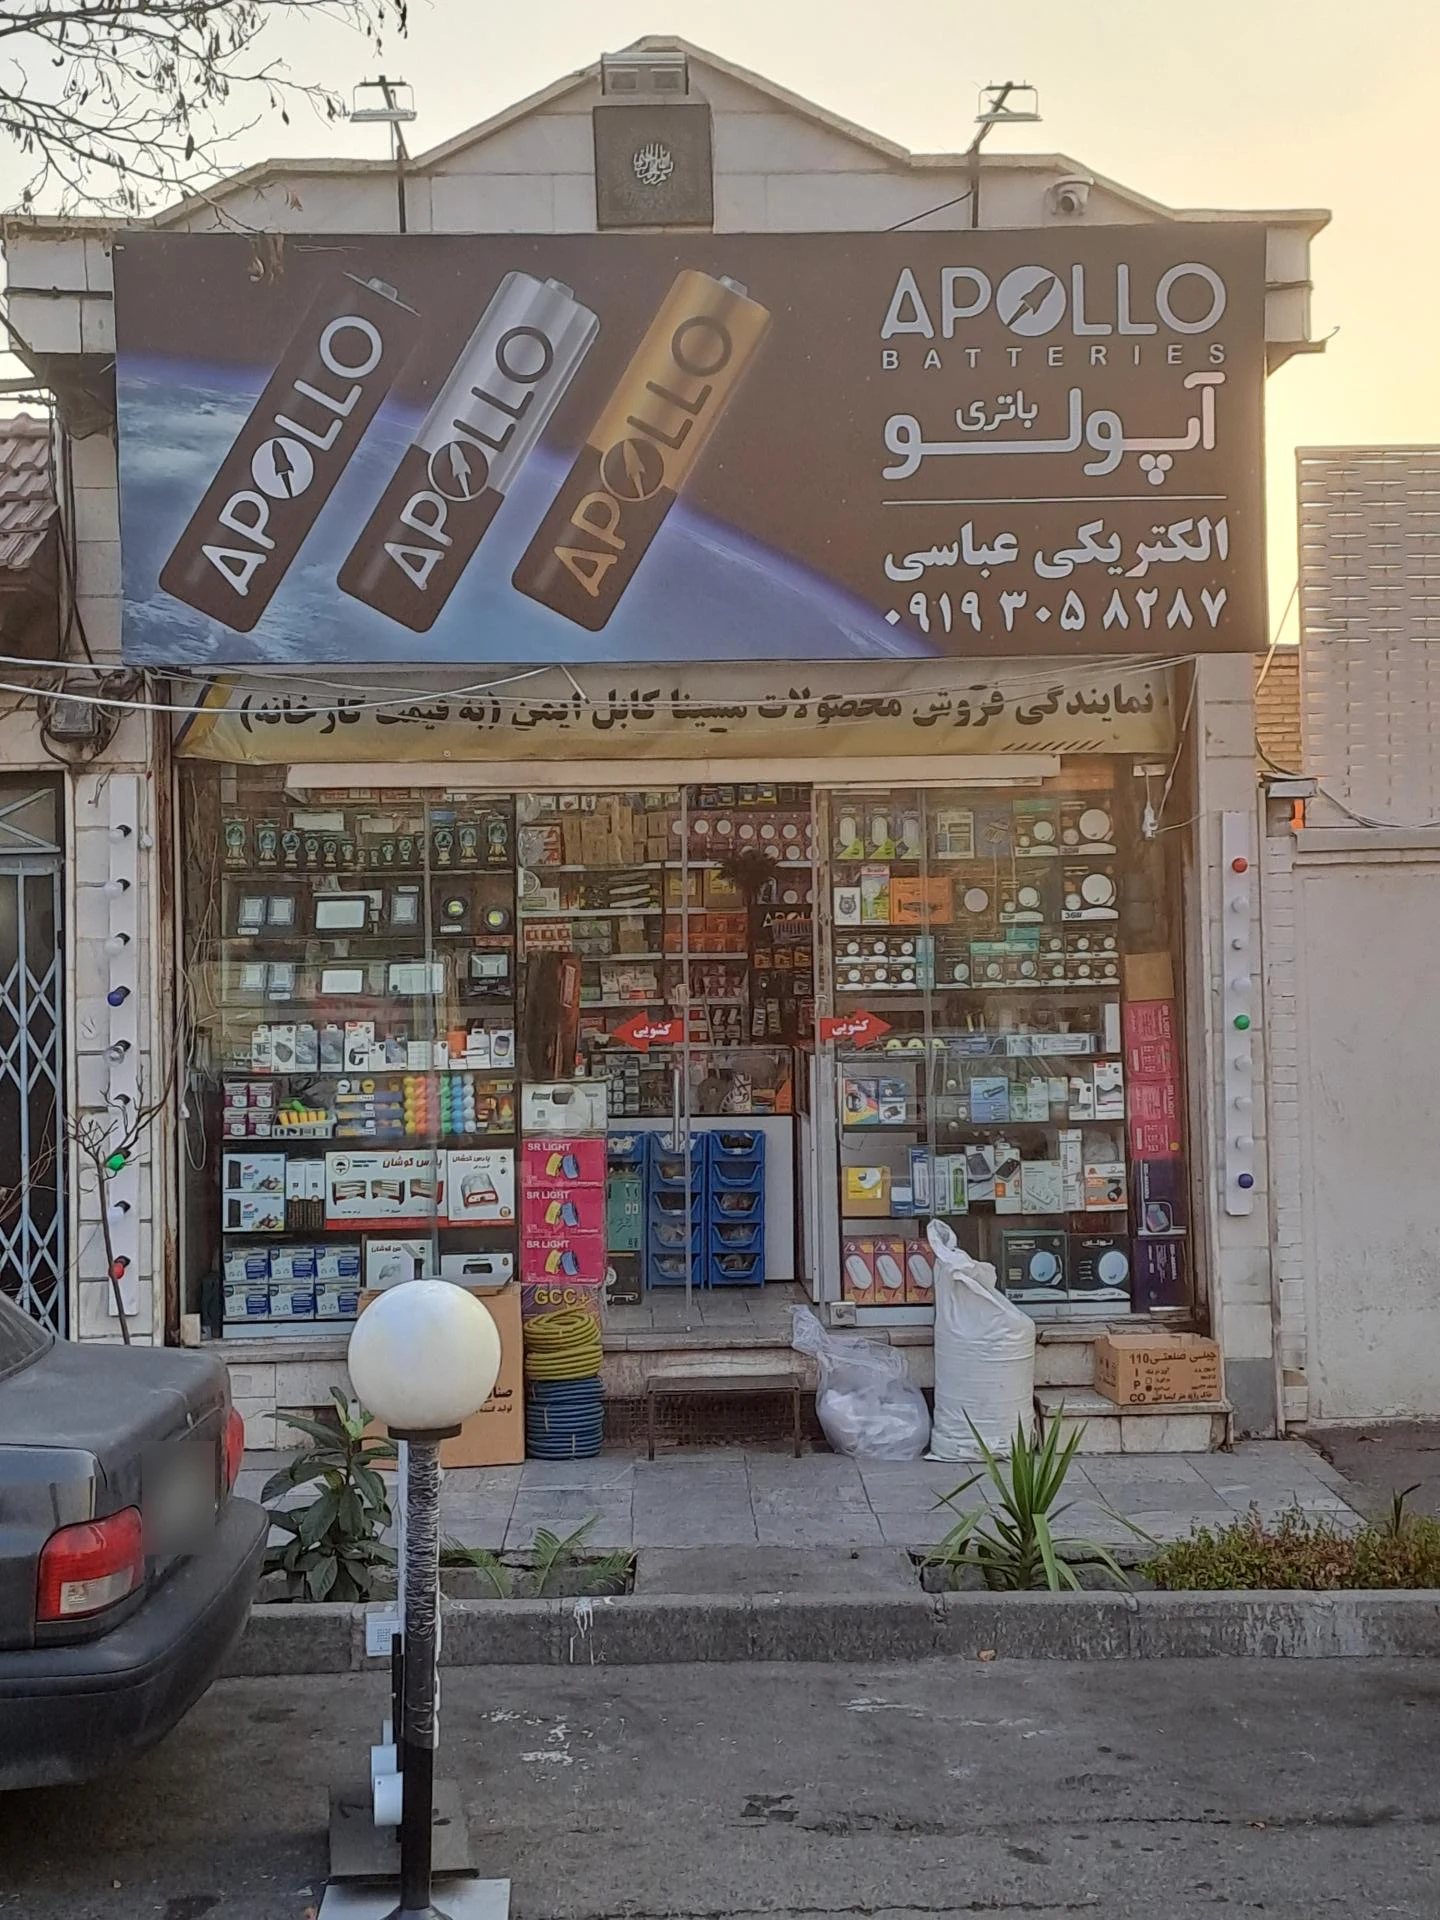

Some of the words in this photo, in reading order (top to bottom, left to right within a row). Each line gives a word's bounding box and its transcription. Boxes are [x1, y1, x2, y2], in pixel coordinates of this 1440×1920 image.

[880, 262, 1227, 340] APOLLO
[881, 344, 1226, 370] BATTERIES
[881, 371, 1227, 486] آپولو
[955, 389, 1039, 431] باتری
[202, 315, 383, 596] APOLLO
[384, 324, 554, 591] APOLLO
[554, 315, 733, 597] APOLLO
[883, 520, 1020, 582] عباسی
[1033, 516, 1230, 579] الکتریکی
[375, 698, 450, 730] قیمت
[591, 688, 661, 730] کابل
[756, 686, 901, 728] محصولات
[912, 682, 1005, 727] فروش
[1016, 684, 1153, 725] نمایندگی
[632, 1022, 672, 1039] کشویی
[543, 1142, 572, 1152] LIGHT
[542, 1190, 571, 1199] LIGHT
[542, 1239, 571, 1248] LIGHT
[535, 1288, 577, 1305] GCC
[1130, 1353, 1150, 1365] 110
[1129, 1392, 1146, 1403] CO
